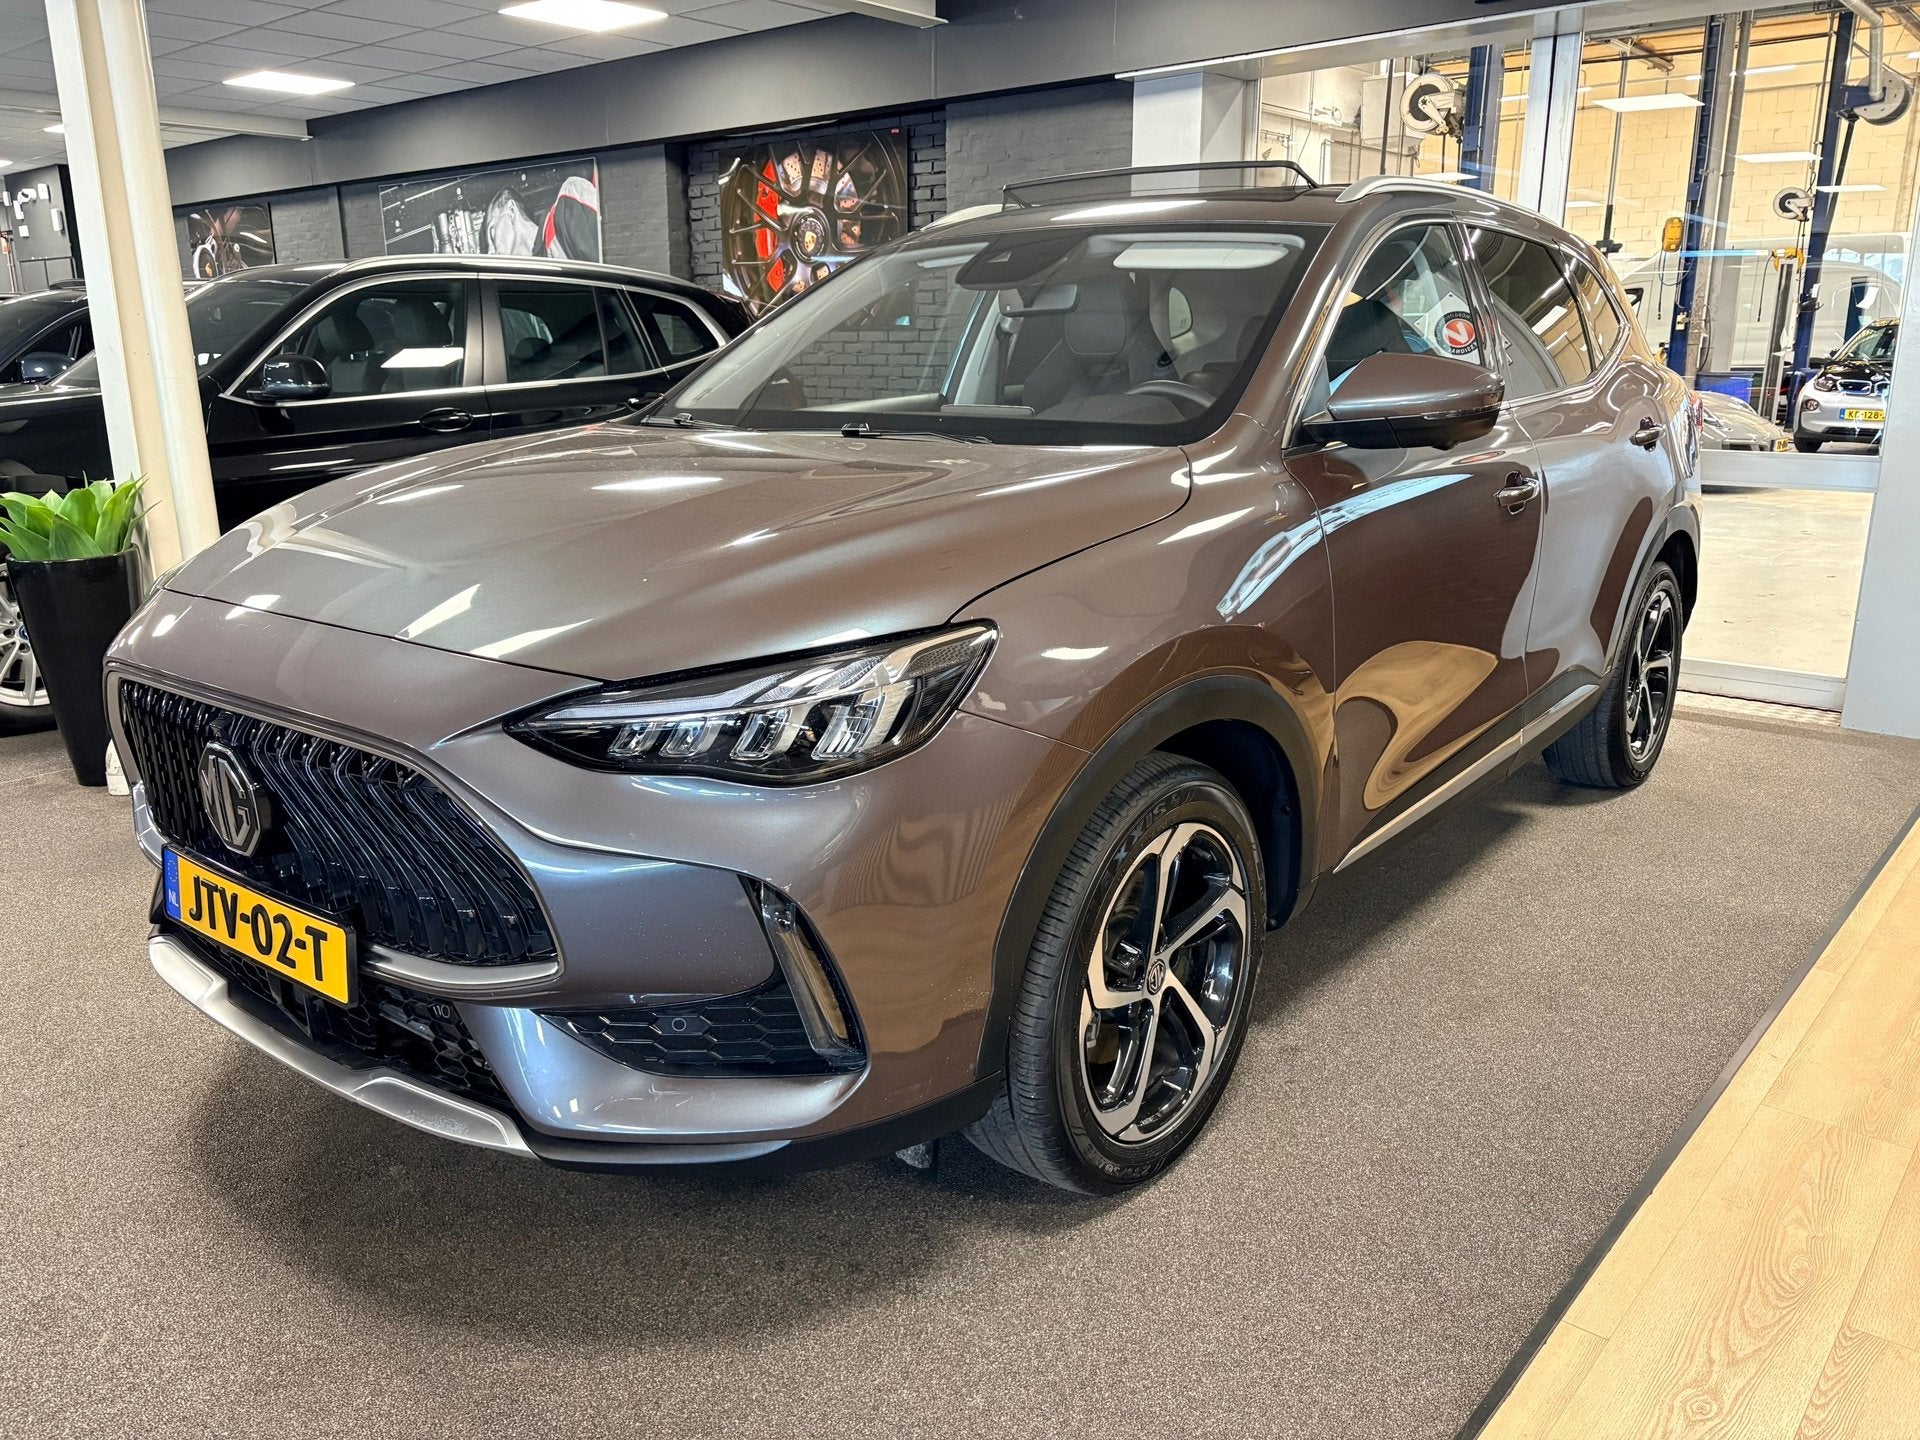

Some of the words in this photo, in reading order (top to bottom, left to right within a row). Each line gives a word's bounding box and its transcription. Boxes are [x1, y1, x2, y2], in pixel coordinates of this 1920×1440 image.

[201, 754, 251, 847] MG
[168, 888, 179, 907] NL
[188, 874, 328, 981] JTV-02-T
